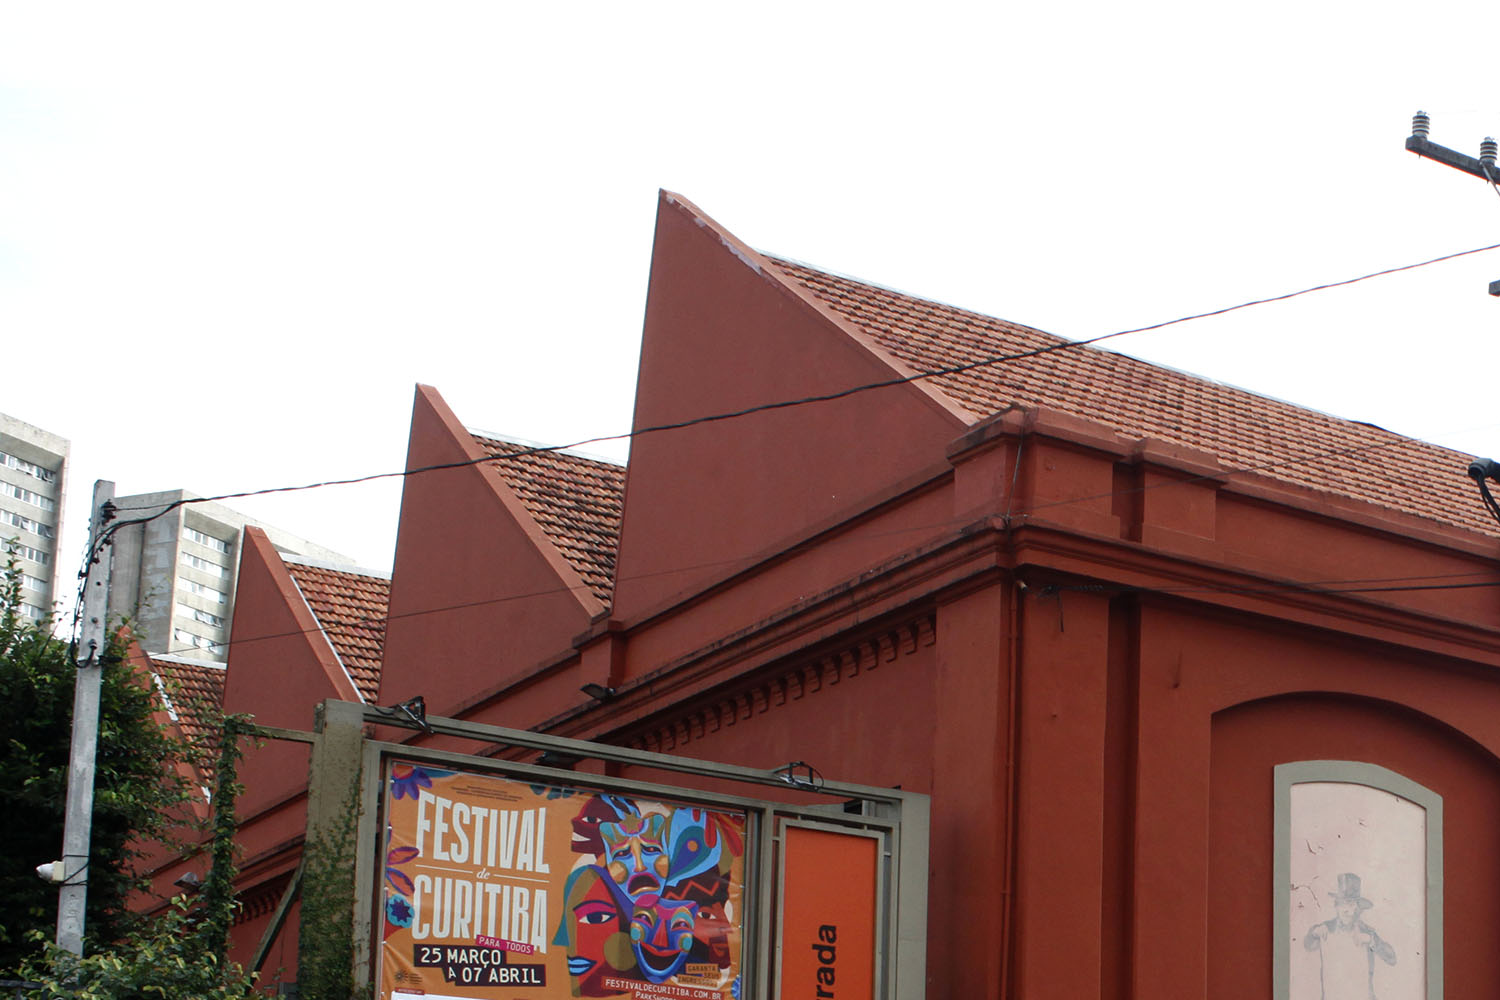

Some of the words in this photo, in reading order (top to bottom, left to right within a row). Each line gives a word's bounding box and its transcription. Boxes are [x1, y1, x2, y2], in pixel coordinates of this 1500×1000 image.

[415, 789, 550, 874] FESTIVAL
[476, 868, 490, 880] de
[411, 874, 547, 954] CURITIBA
[479, 936, 500, 948] PARA
[506, 941, 532, 954] TODOS
[421, 947, 442, 963] 25
[447, 949, 501, 968] MARÇO
[448, 967, 457, 979] A
[462, 967, 482, 983] 07
[488, 968, 541, 984] ABRIL
[605, 979, 721, 1000] FESTIVALDECURITIBA.COM.BR
